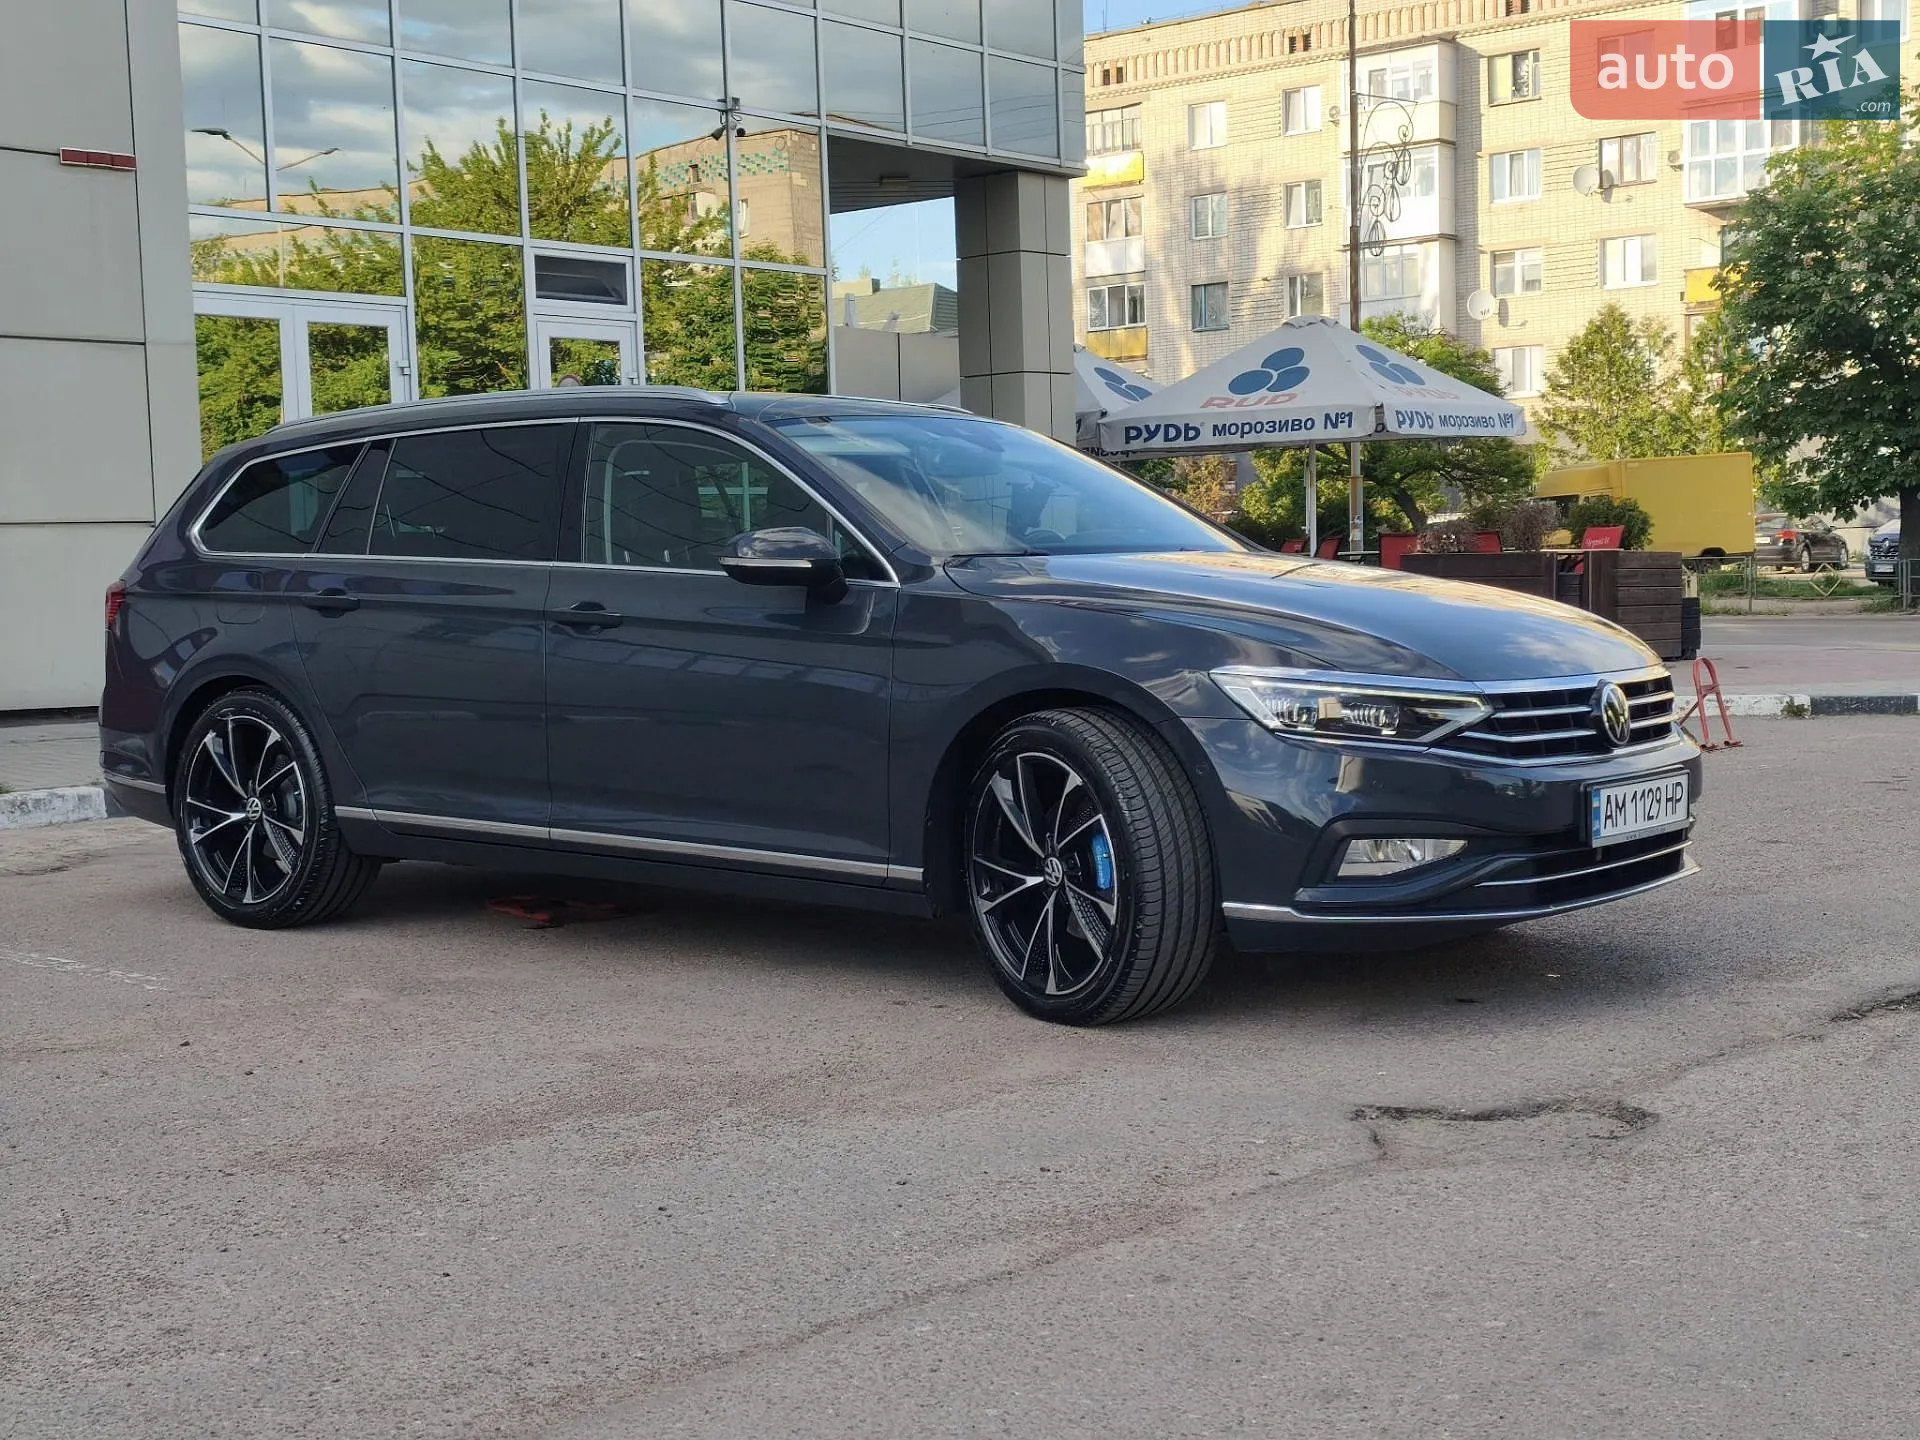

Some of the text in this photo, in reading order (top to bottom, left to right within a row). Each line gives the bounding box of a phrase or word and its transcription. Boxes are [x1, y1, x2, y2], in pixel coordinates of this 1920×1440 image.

[1200, 393, 1298, 409] RUD
[1212, 417, 1316, 438] морозиво
[1323, 411, 1353, 430] №1
[1438, 414, 1496, 430] морозиво
[1604, 792, 1627, 829] AM
[1631, 786, 1661, 824] 1129
